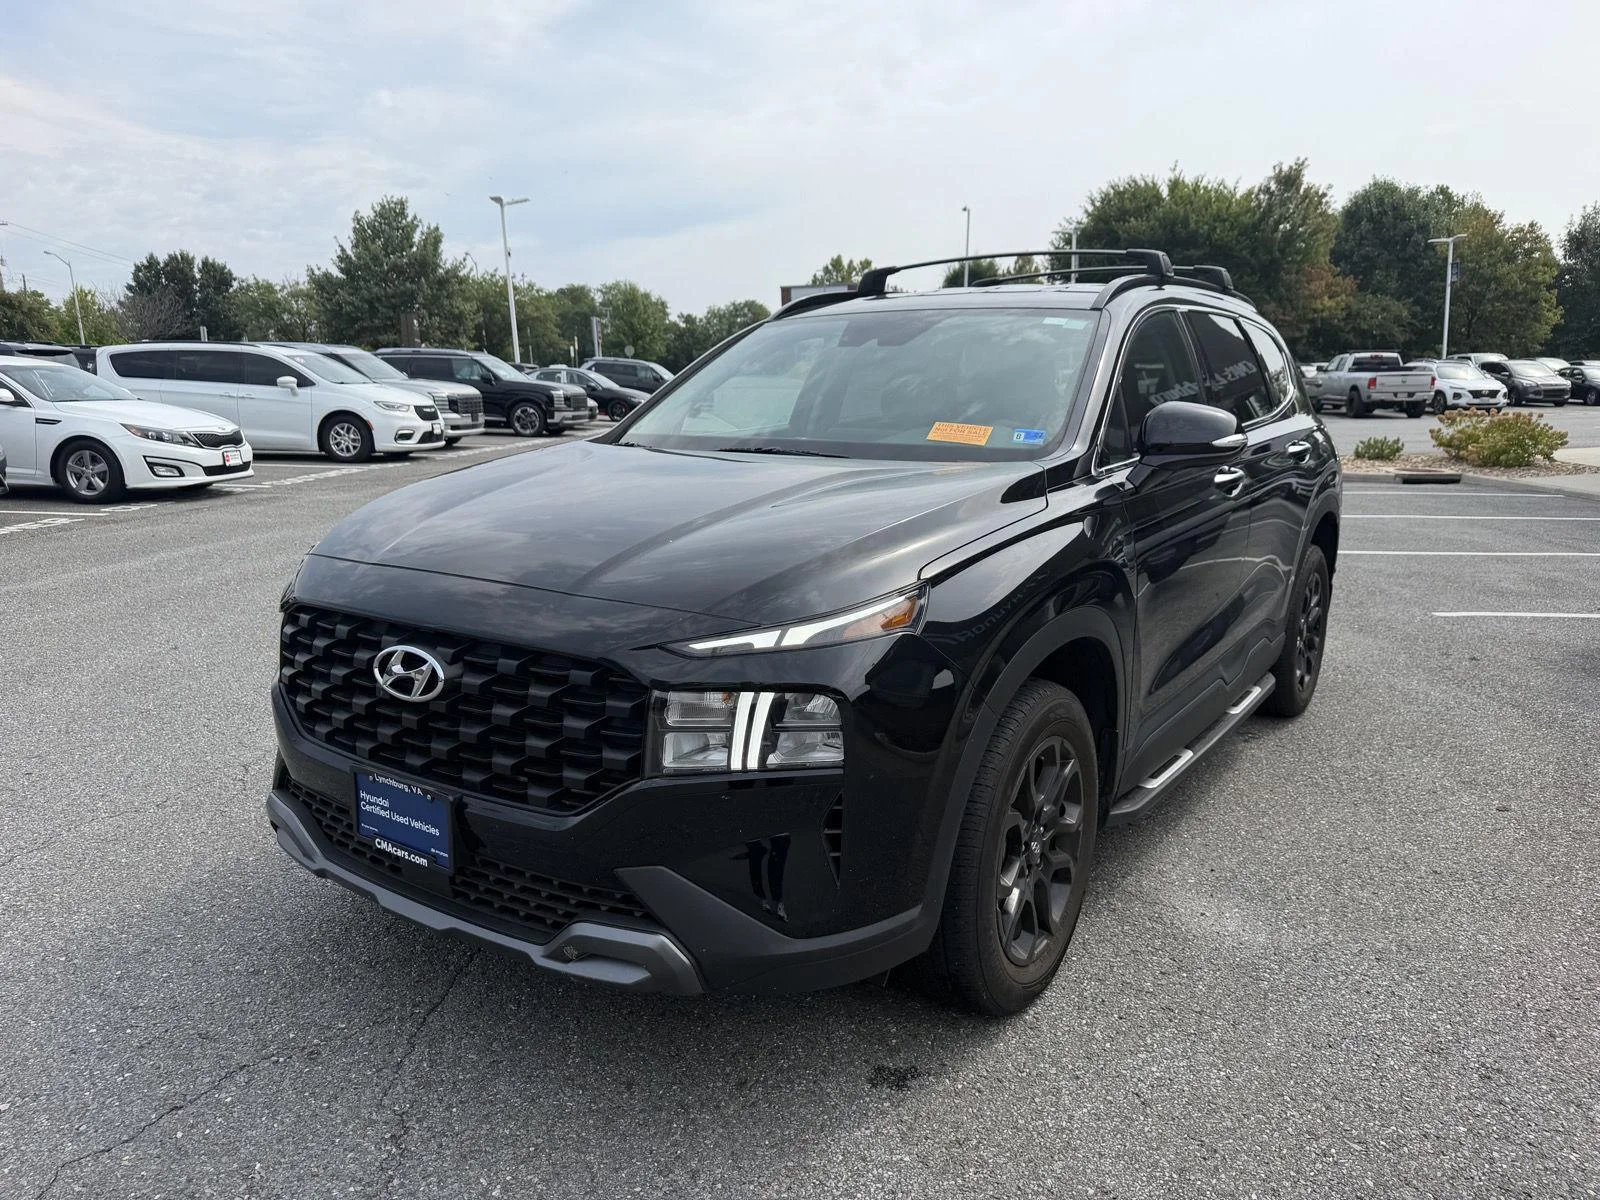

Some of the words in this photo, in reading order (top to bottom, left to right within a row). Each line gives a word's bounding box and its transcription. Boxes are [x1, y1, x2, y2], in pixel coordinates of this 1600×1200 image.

[374, 773, 411, 793] Lynchburg,
[411, 784, 424, 796] VA
[360, 790, 389, 808] Hyundai
[360, 801, 390, 818] Certified
[391, 811, 409, 825] Used
[409, 818, 440, 836] Vehicles
[375, 838, 428, 867] CMAcars.com
